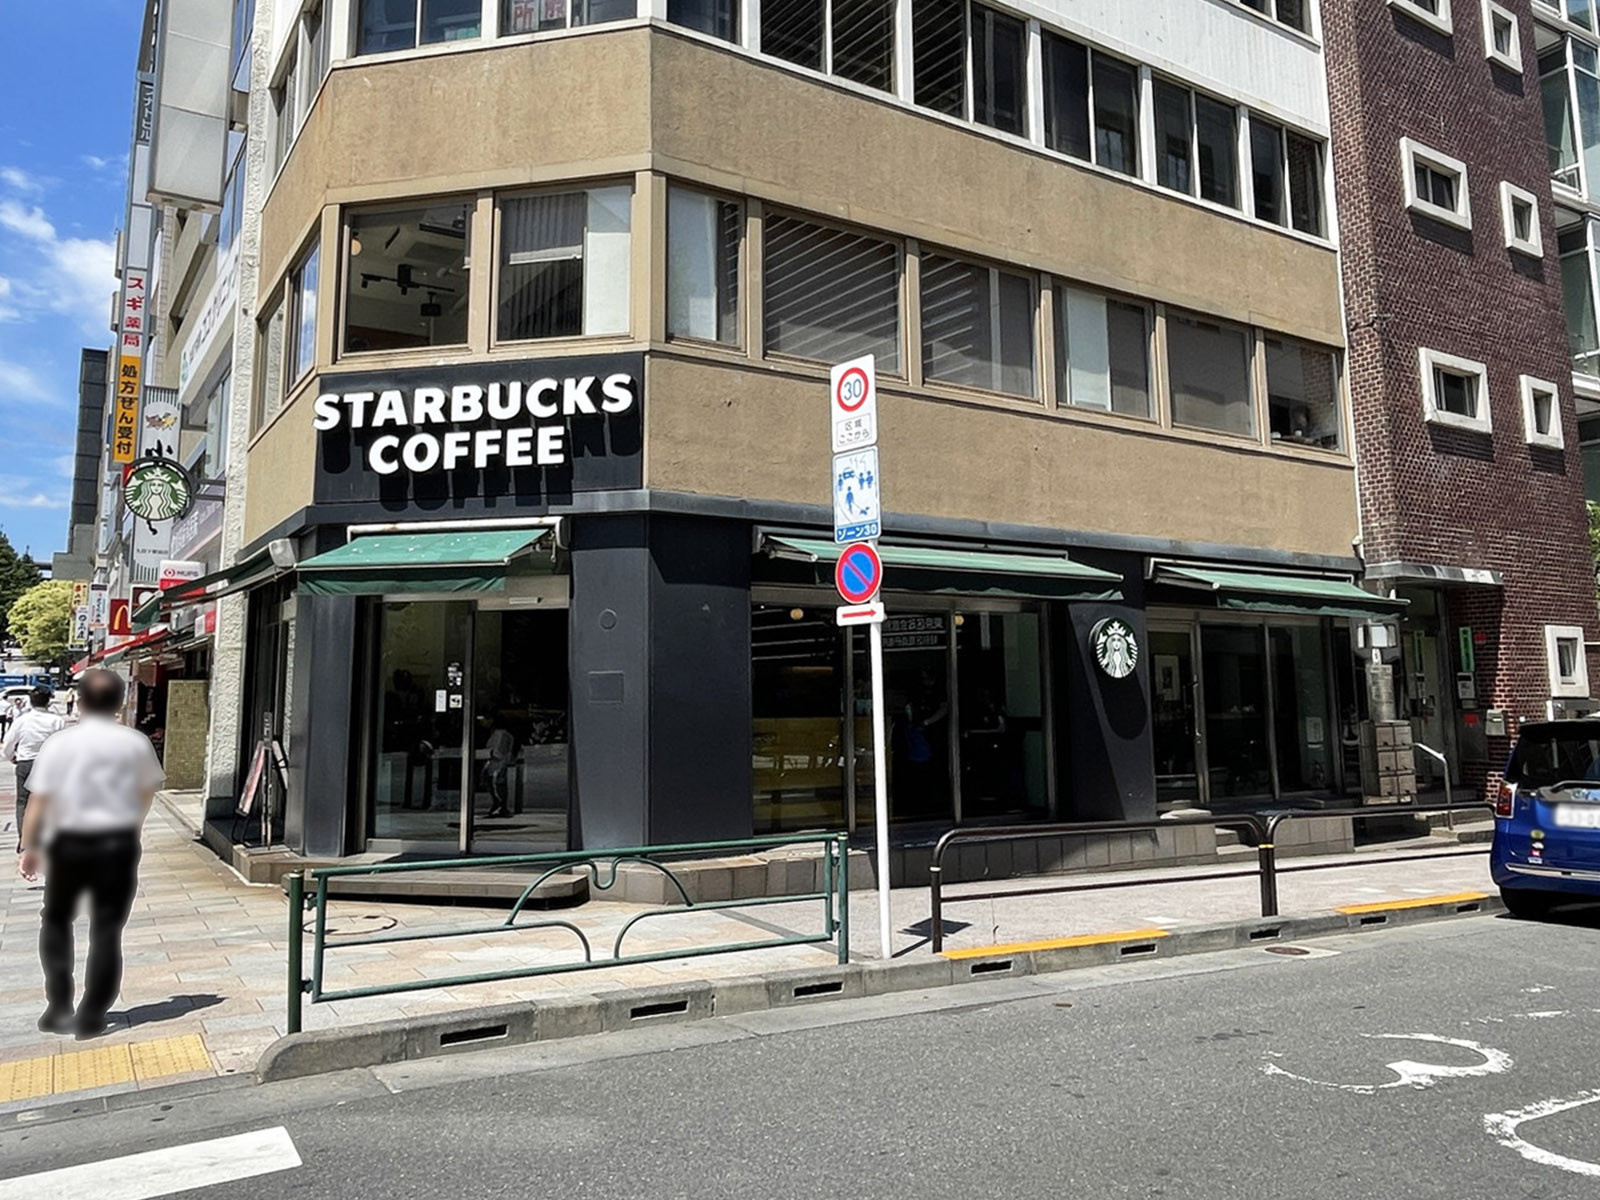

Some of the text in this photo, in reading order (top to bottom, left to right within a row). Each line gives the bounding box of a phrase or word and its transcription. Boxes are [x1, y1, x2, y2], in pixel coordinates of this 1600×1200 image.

[123, 276, 145, 348] スギ薬局
[116, 364, 138, 455] 処方せん受付
[312, 373, 634, 431] STARBUCKS
[843, 378, 862, 401] 30
[369, 426, 565, 475] COFFEE
[838, 428, 870, 444] ここから
